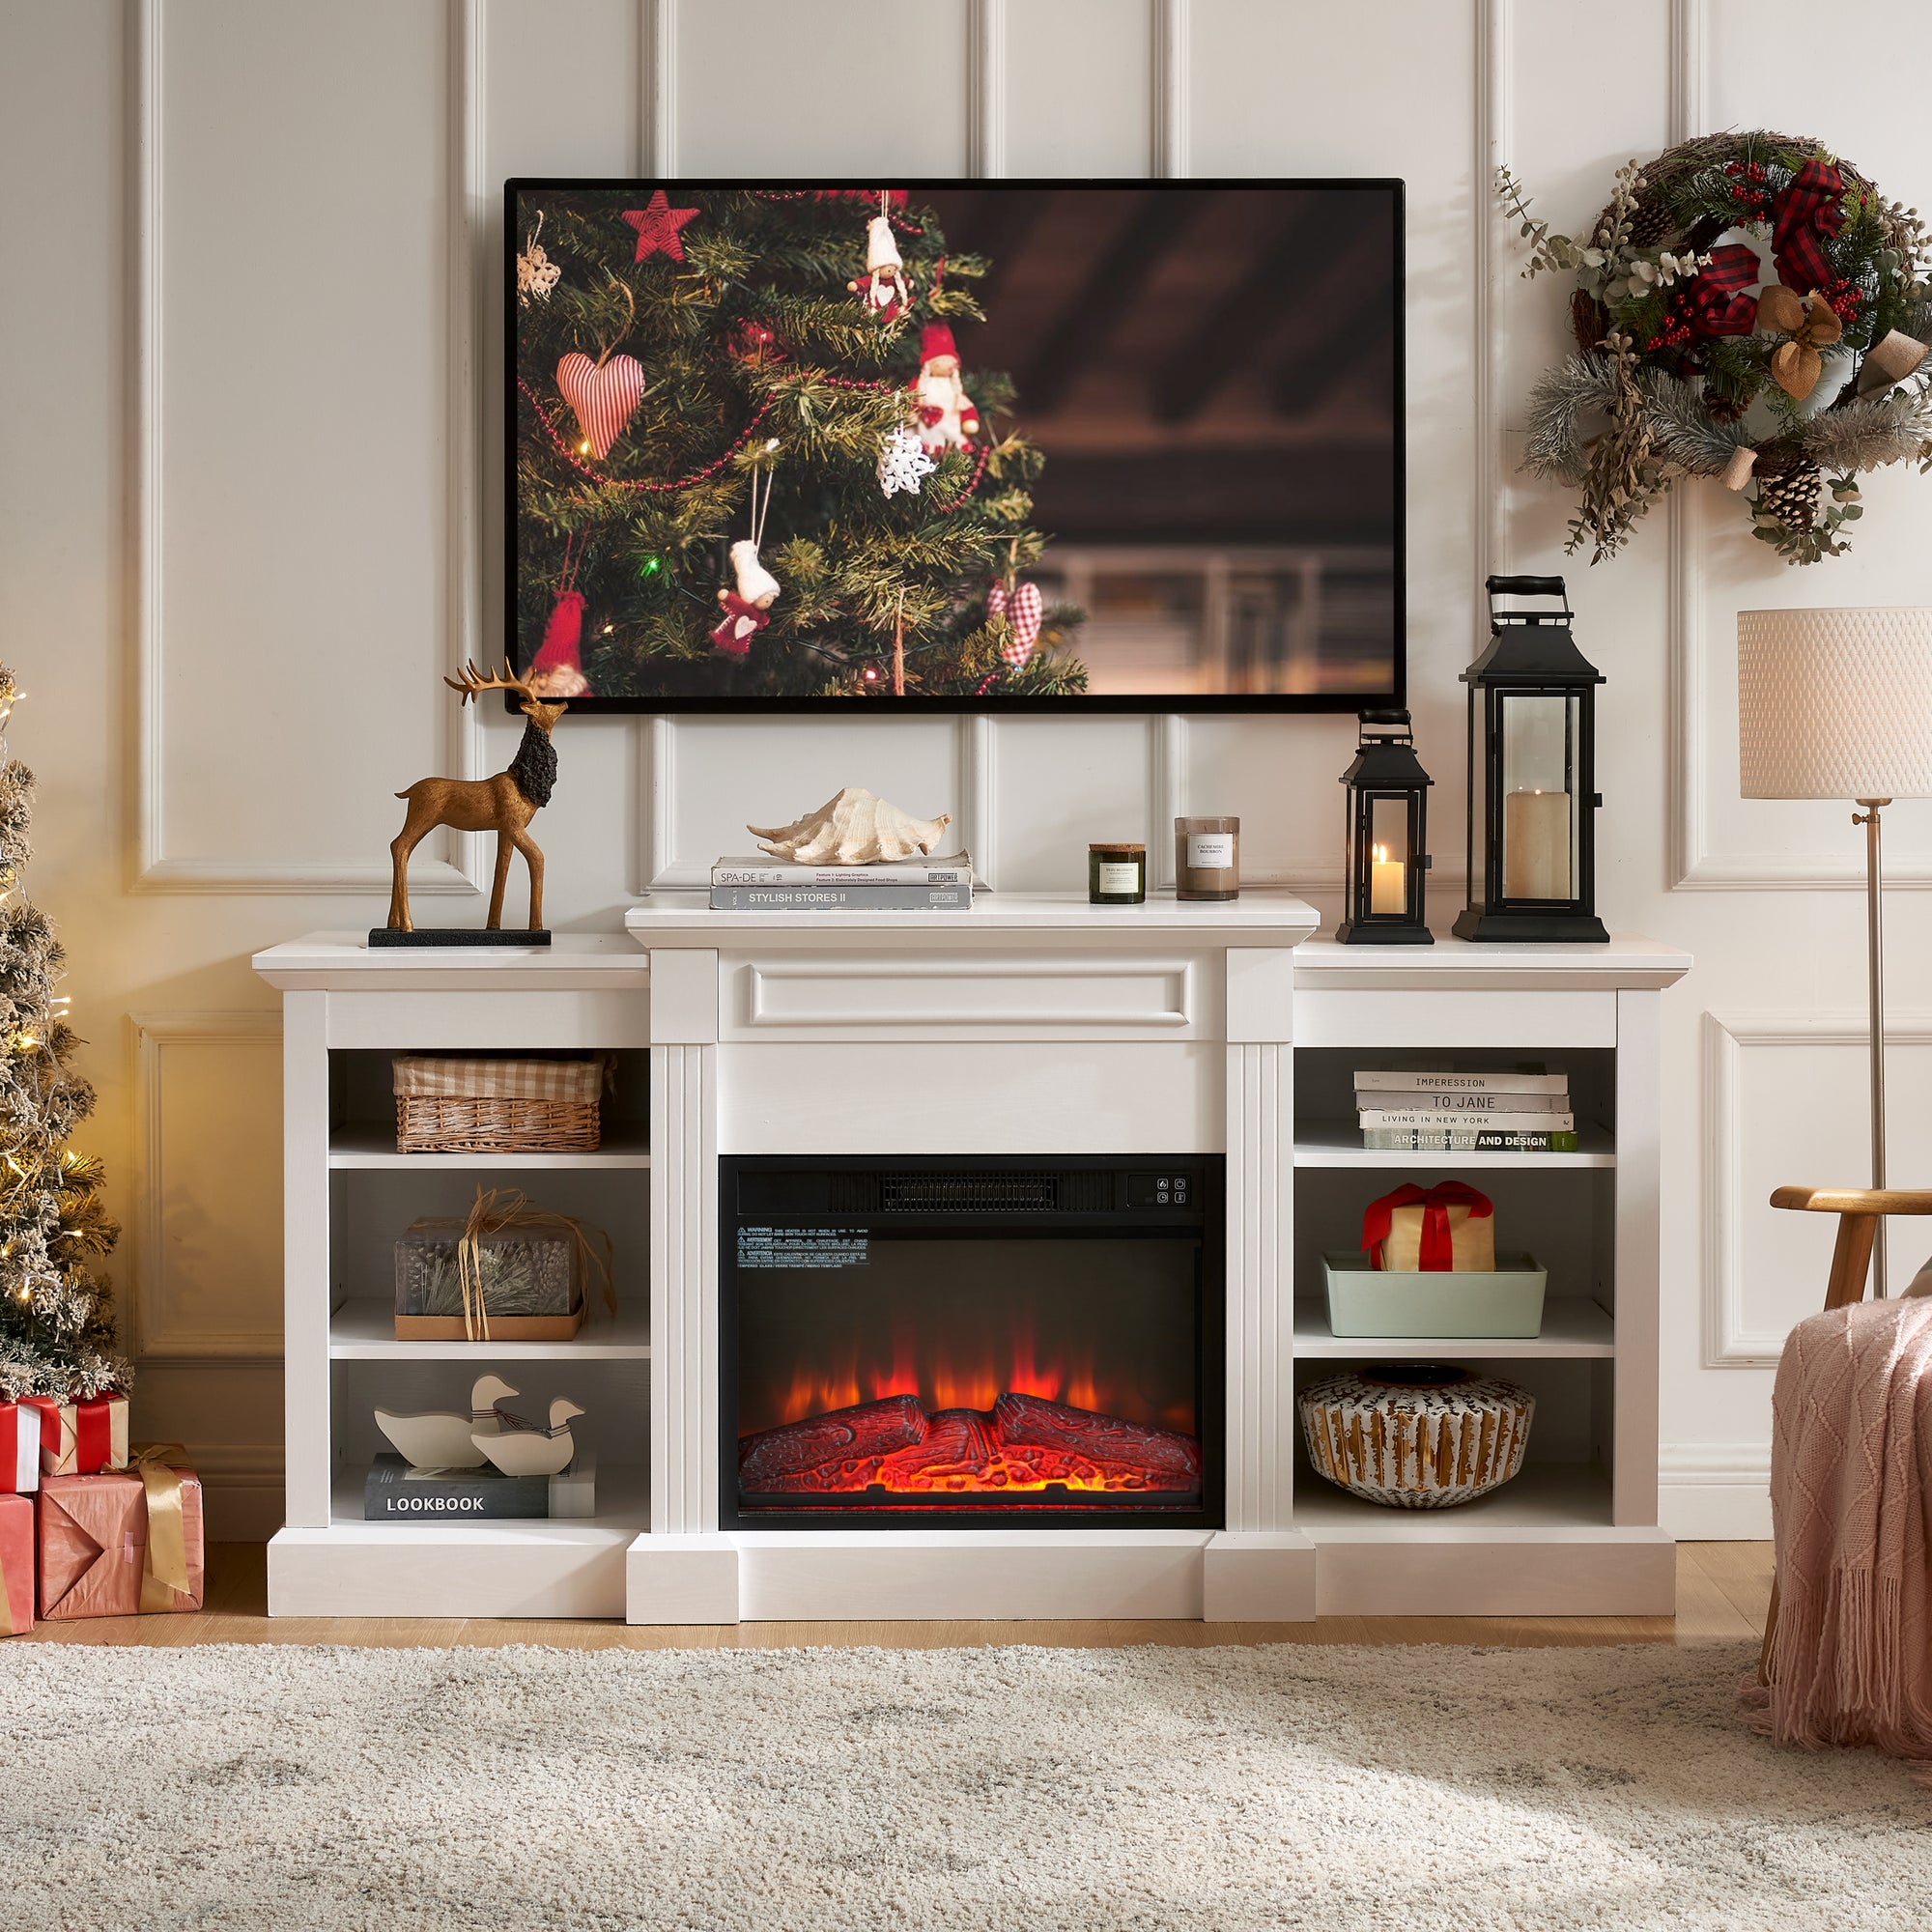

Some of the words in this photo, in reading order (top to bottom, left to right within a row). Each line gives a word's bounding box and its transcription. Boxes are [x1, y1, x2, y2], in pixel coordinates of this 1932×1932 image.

[721, 872, 756, 883] SPA-DE
[749, 893, 792, 902] STYLISH
[795, 893, 837, 902] STORES
[1415, 1078, 1486, 1088] IMPERESSION
[1433, 1095, 1451, 1108] TO
[1456, 1096, 1495, 1109] JANE
[1394, 1134, 1476, 1146] ARCHITECTURE
[1478, 1135, 1501, 1147] AND
[1504, 1135, 1547, 1147] DESIGN
[386, 1497, 485, 1511] LOOKBOOK
